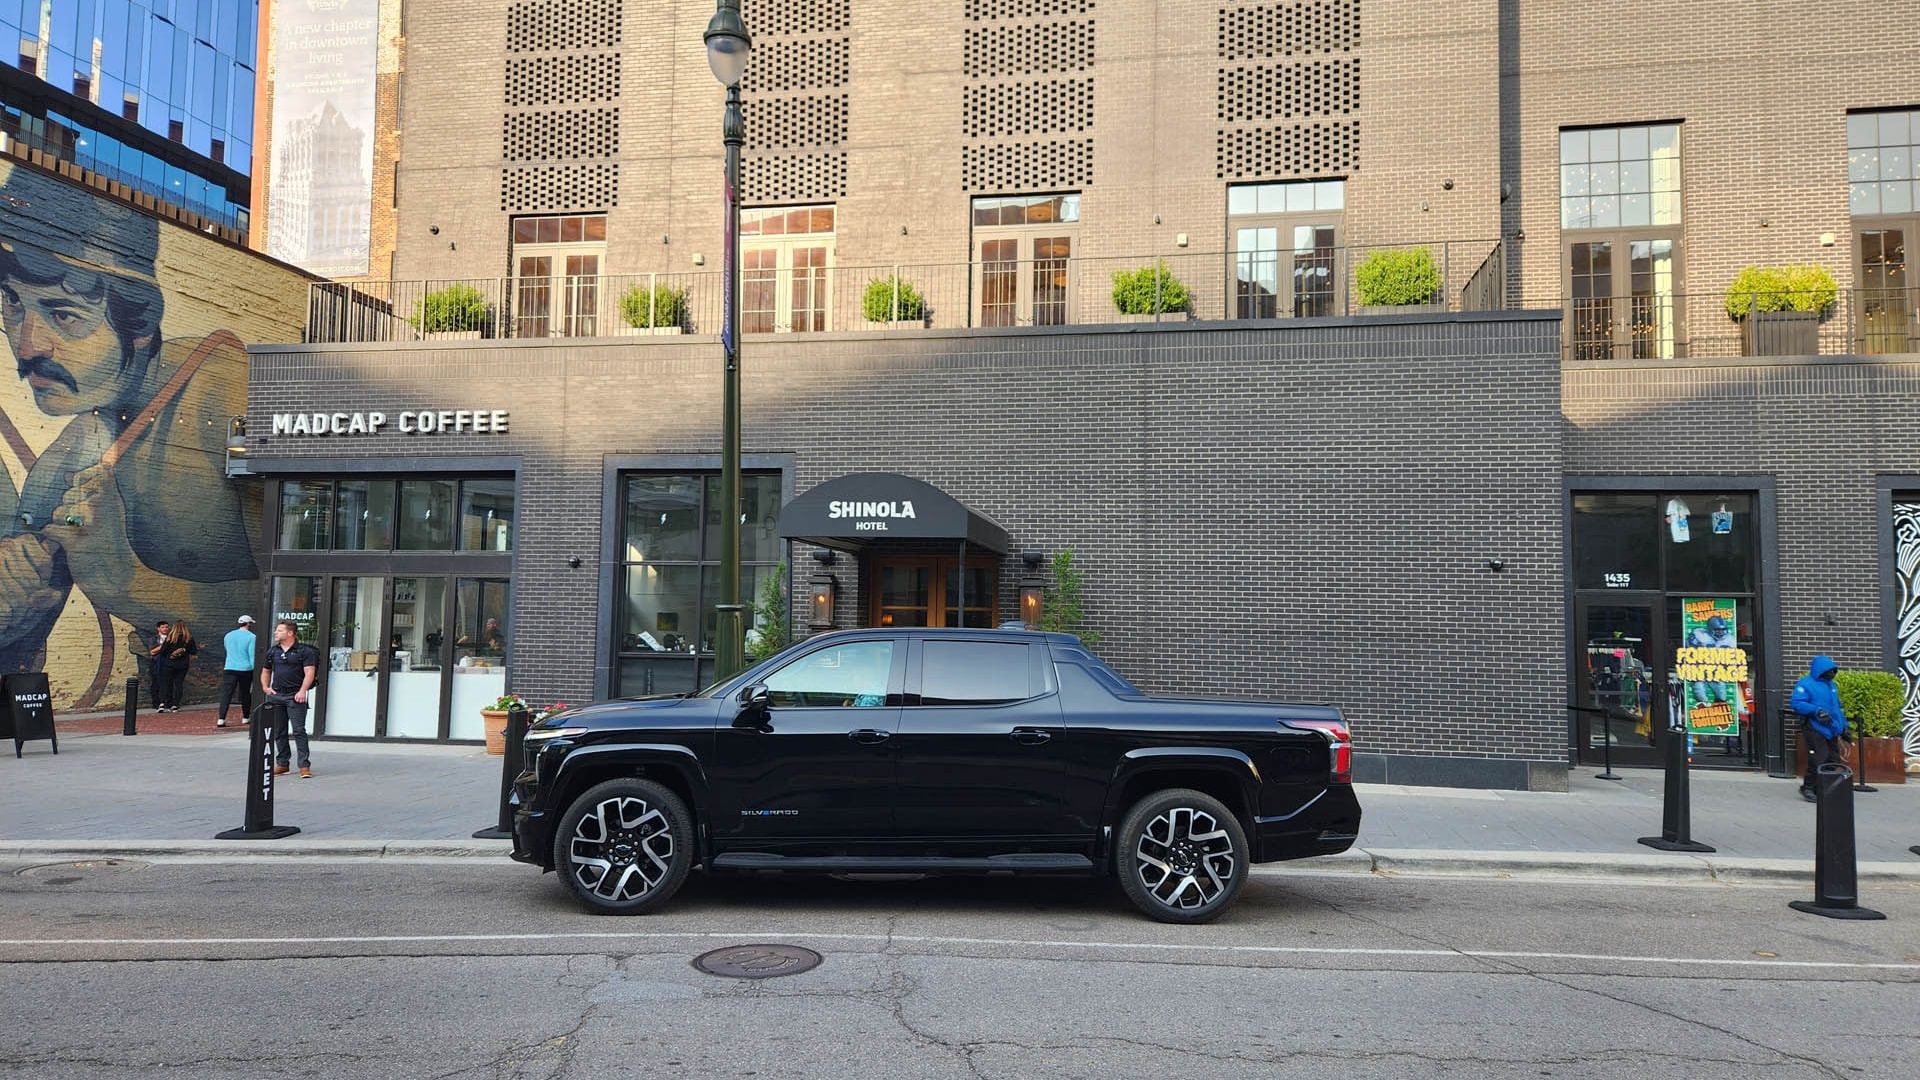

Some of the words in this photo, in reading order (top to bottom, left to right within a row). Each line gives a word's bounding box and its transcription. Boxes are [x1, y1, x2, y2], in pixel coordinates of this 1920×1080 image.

[295, 23, 321, 35] new
[324, 19, 371, 34] chapter
[285, 37, 297, 50] in
[300, 36, 369, 49] downtown
[309, 52, 344, 65] living
[272, 412, 387, 435] MADCAP
[398, 410, 510, 433] COFFEE
[828, 500, 917, 519] SHINOLA
[855, 521, 889, 531] HOTEL
[1603, 573, 1631, 583] 1435
[1685, 600, 1715, 613] BARRY
[278, 612, 314, 620] MADCAP
[1692, 608, 1733, 622] SANDERS
[1676, 647, 1747, 665] FORMER
[1675, 664, 1748, 681] VINTAGE
[15, 693, 48, 702] MADCAP
[262, 727, 272, 801] VALET
